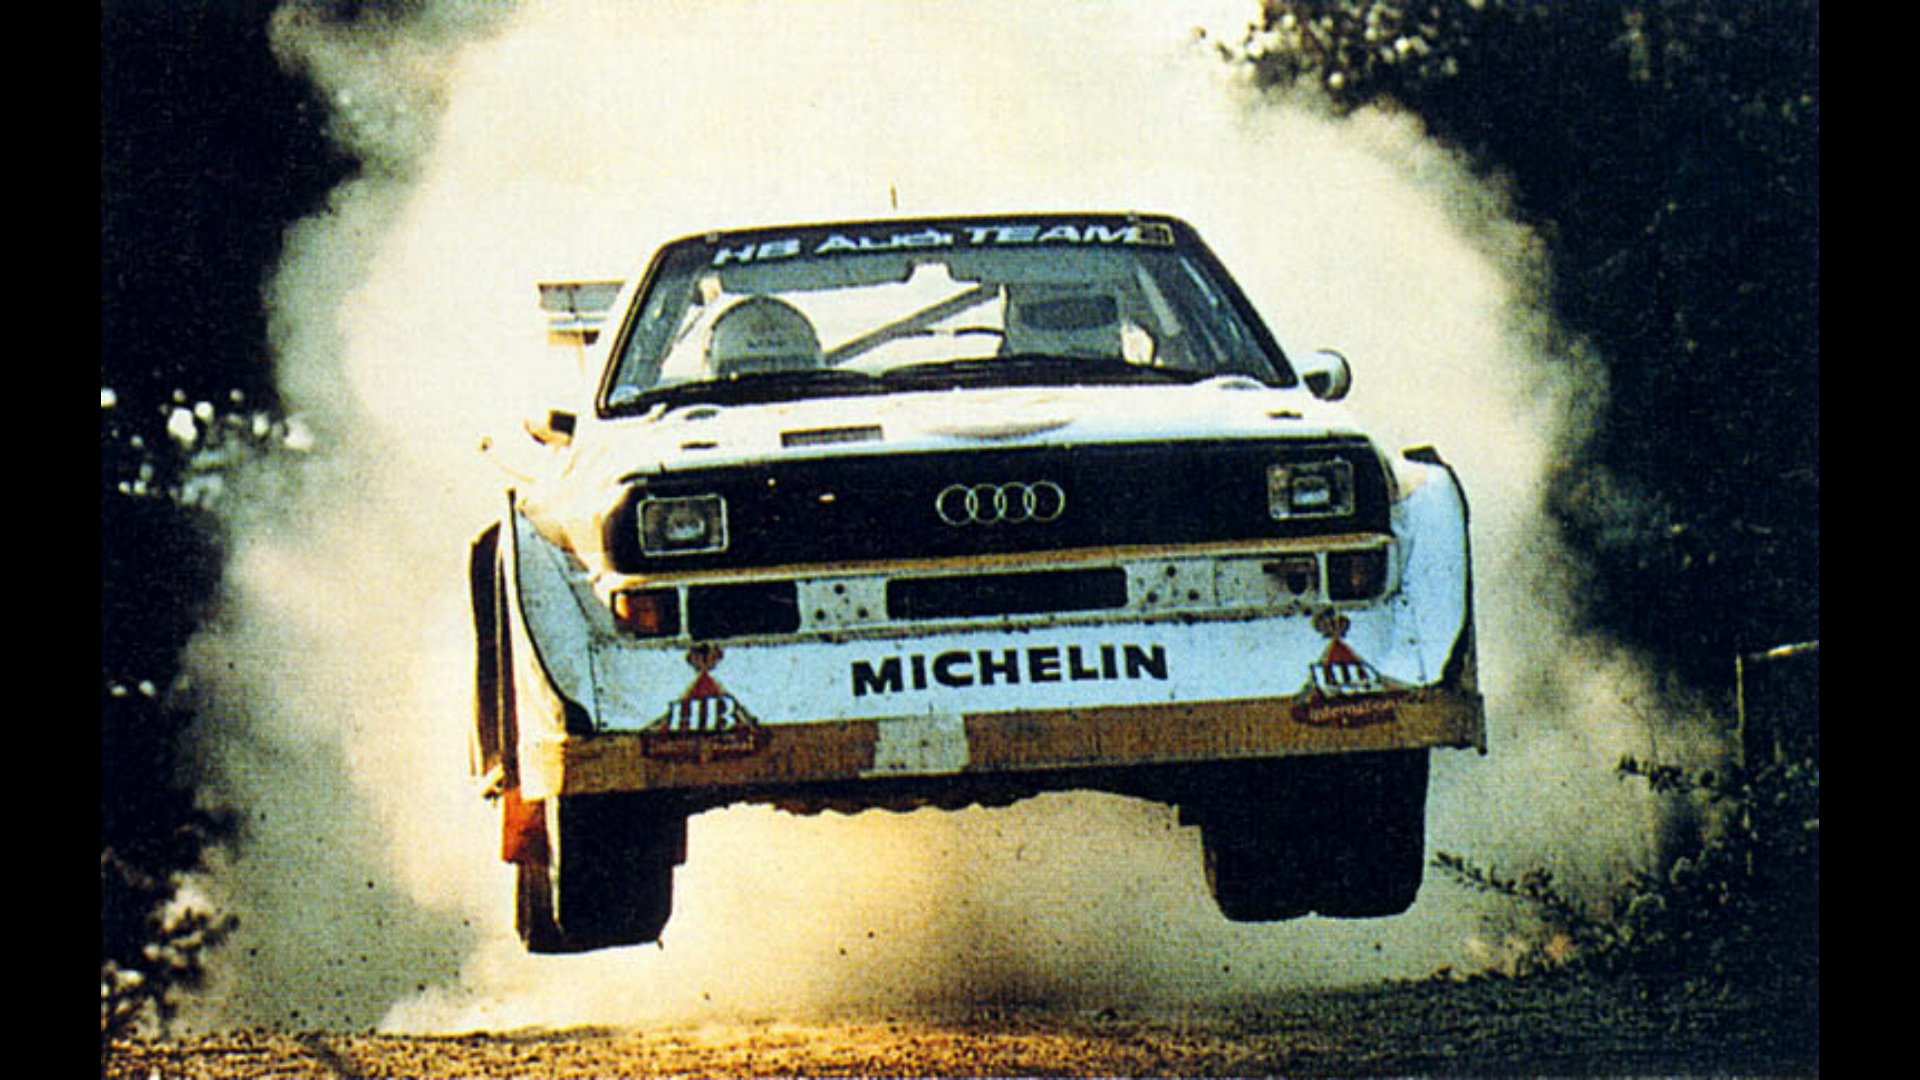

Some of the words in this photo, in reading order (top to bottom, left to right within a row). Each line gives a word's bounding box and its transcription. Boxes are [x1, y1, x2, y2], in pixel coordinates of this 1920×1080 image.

[712, 239, 800, 266] HB
[964, 223, 1138, 244] TEAM
[851, 644, 1168, 697] MICHELIN
[668, 696, 737, 732] HB
